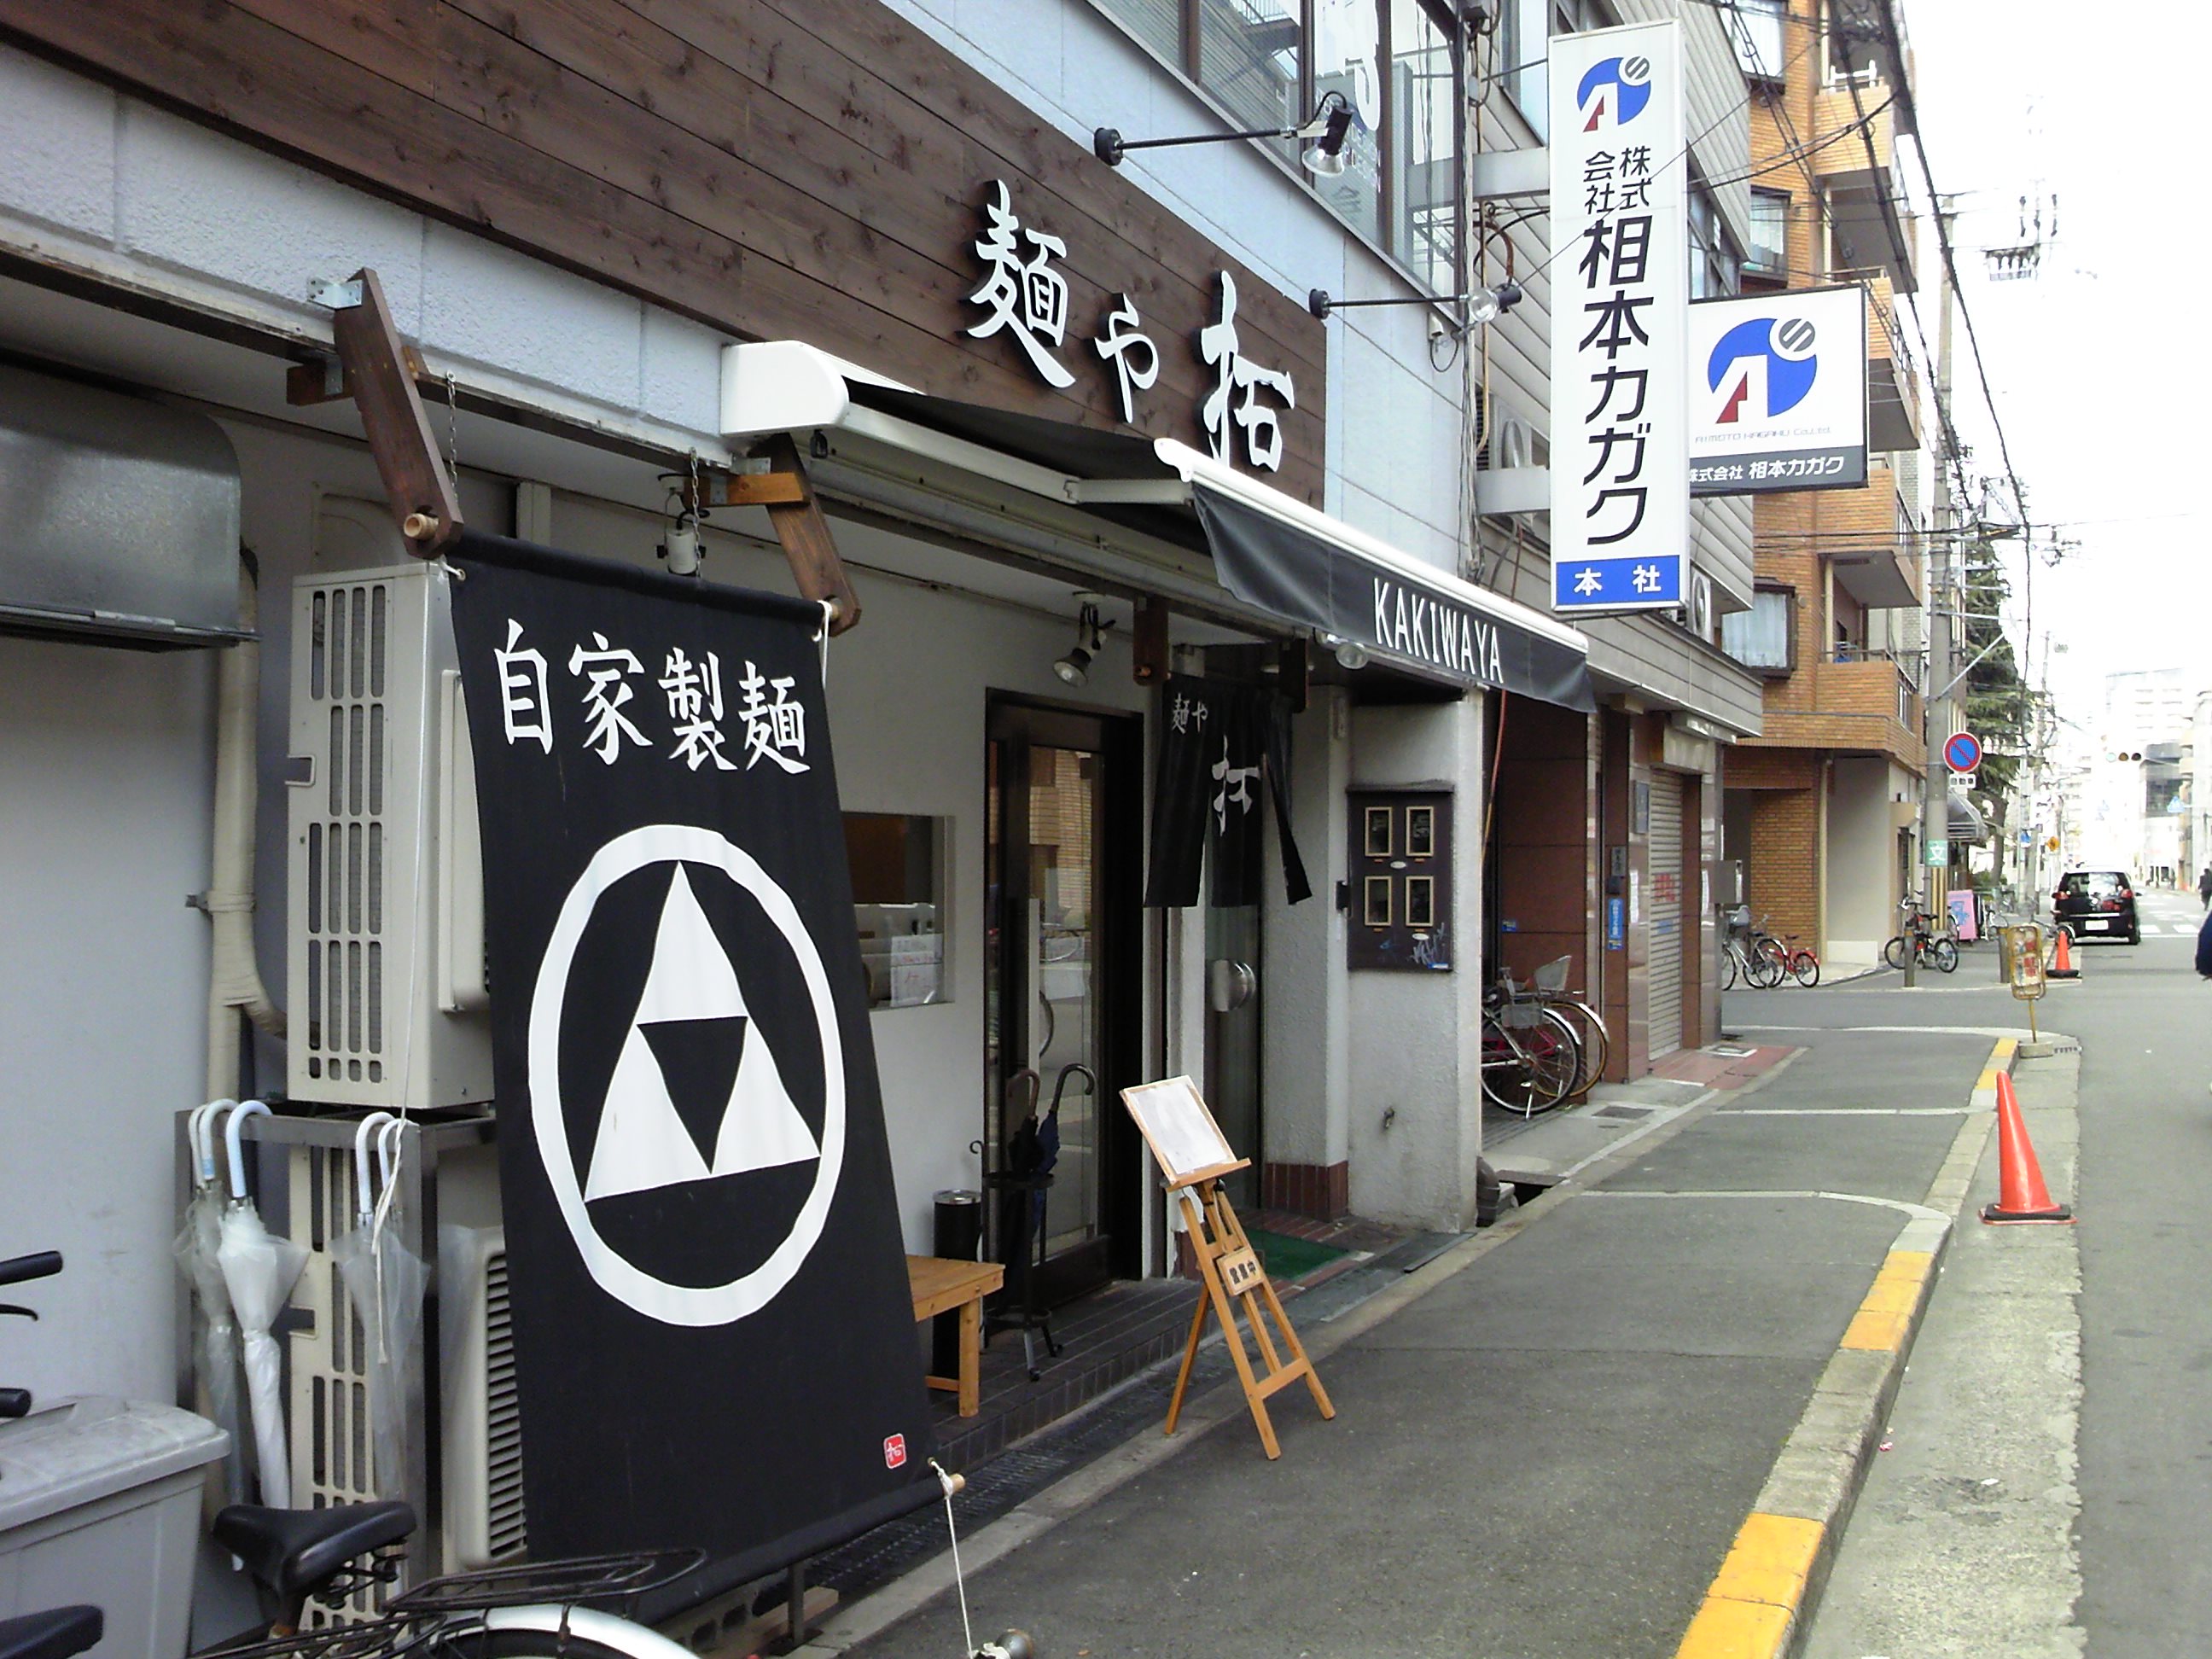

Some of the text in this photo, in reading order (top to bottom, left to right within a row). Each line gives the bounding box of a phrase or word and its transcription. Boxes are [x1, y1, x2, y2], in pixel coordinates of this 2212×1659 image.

[1579, 215, 1654, 546] 相本カガク
[1749, 455, 1845, 480] 相本カガク
[1373, 577, 1505, 684] KAKIWAYA
[493, 618, 812, 775] 自家製麺
[1171, 692, 1209, 736] 麺や
